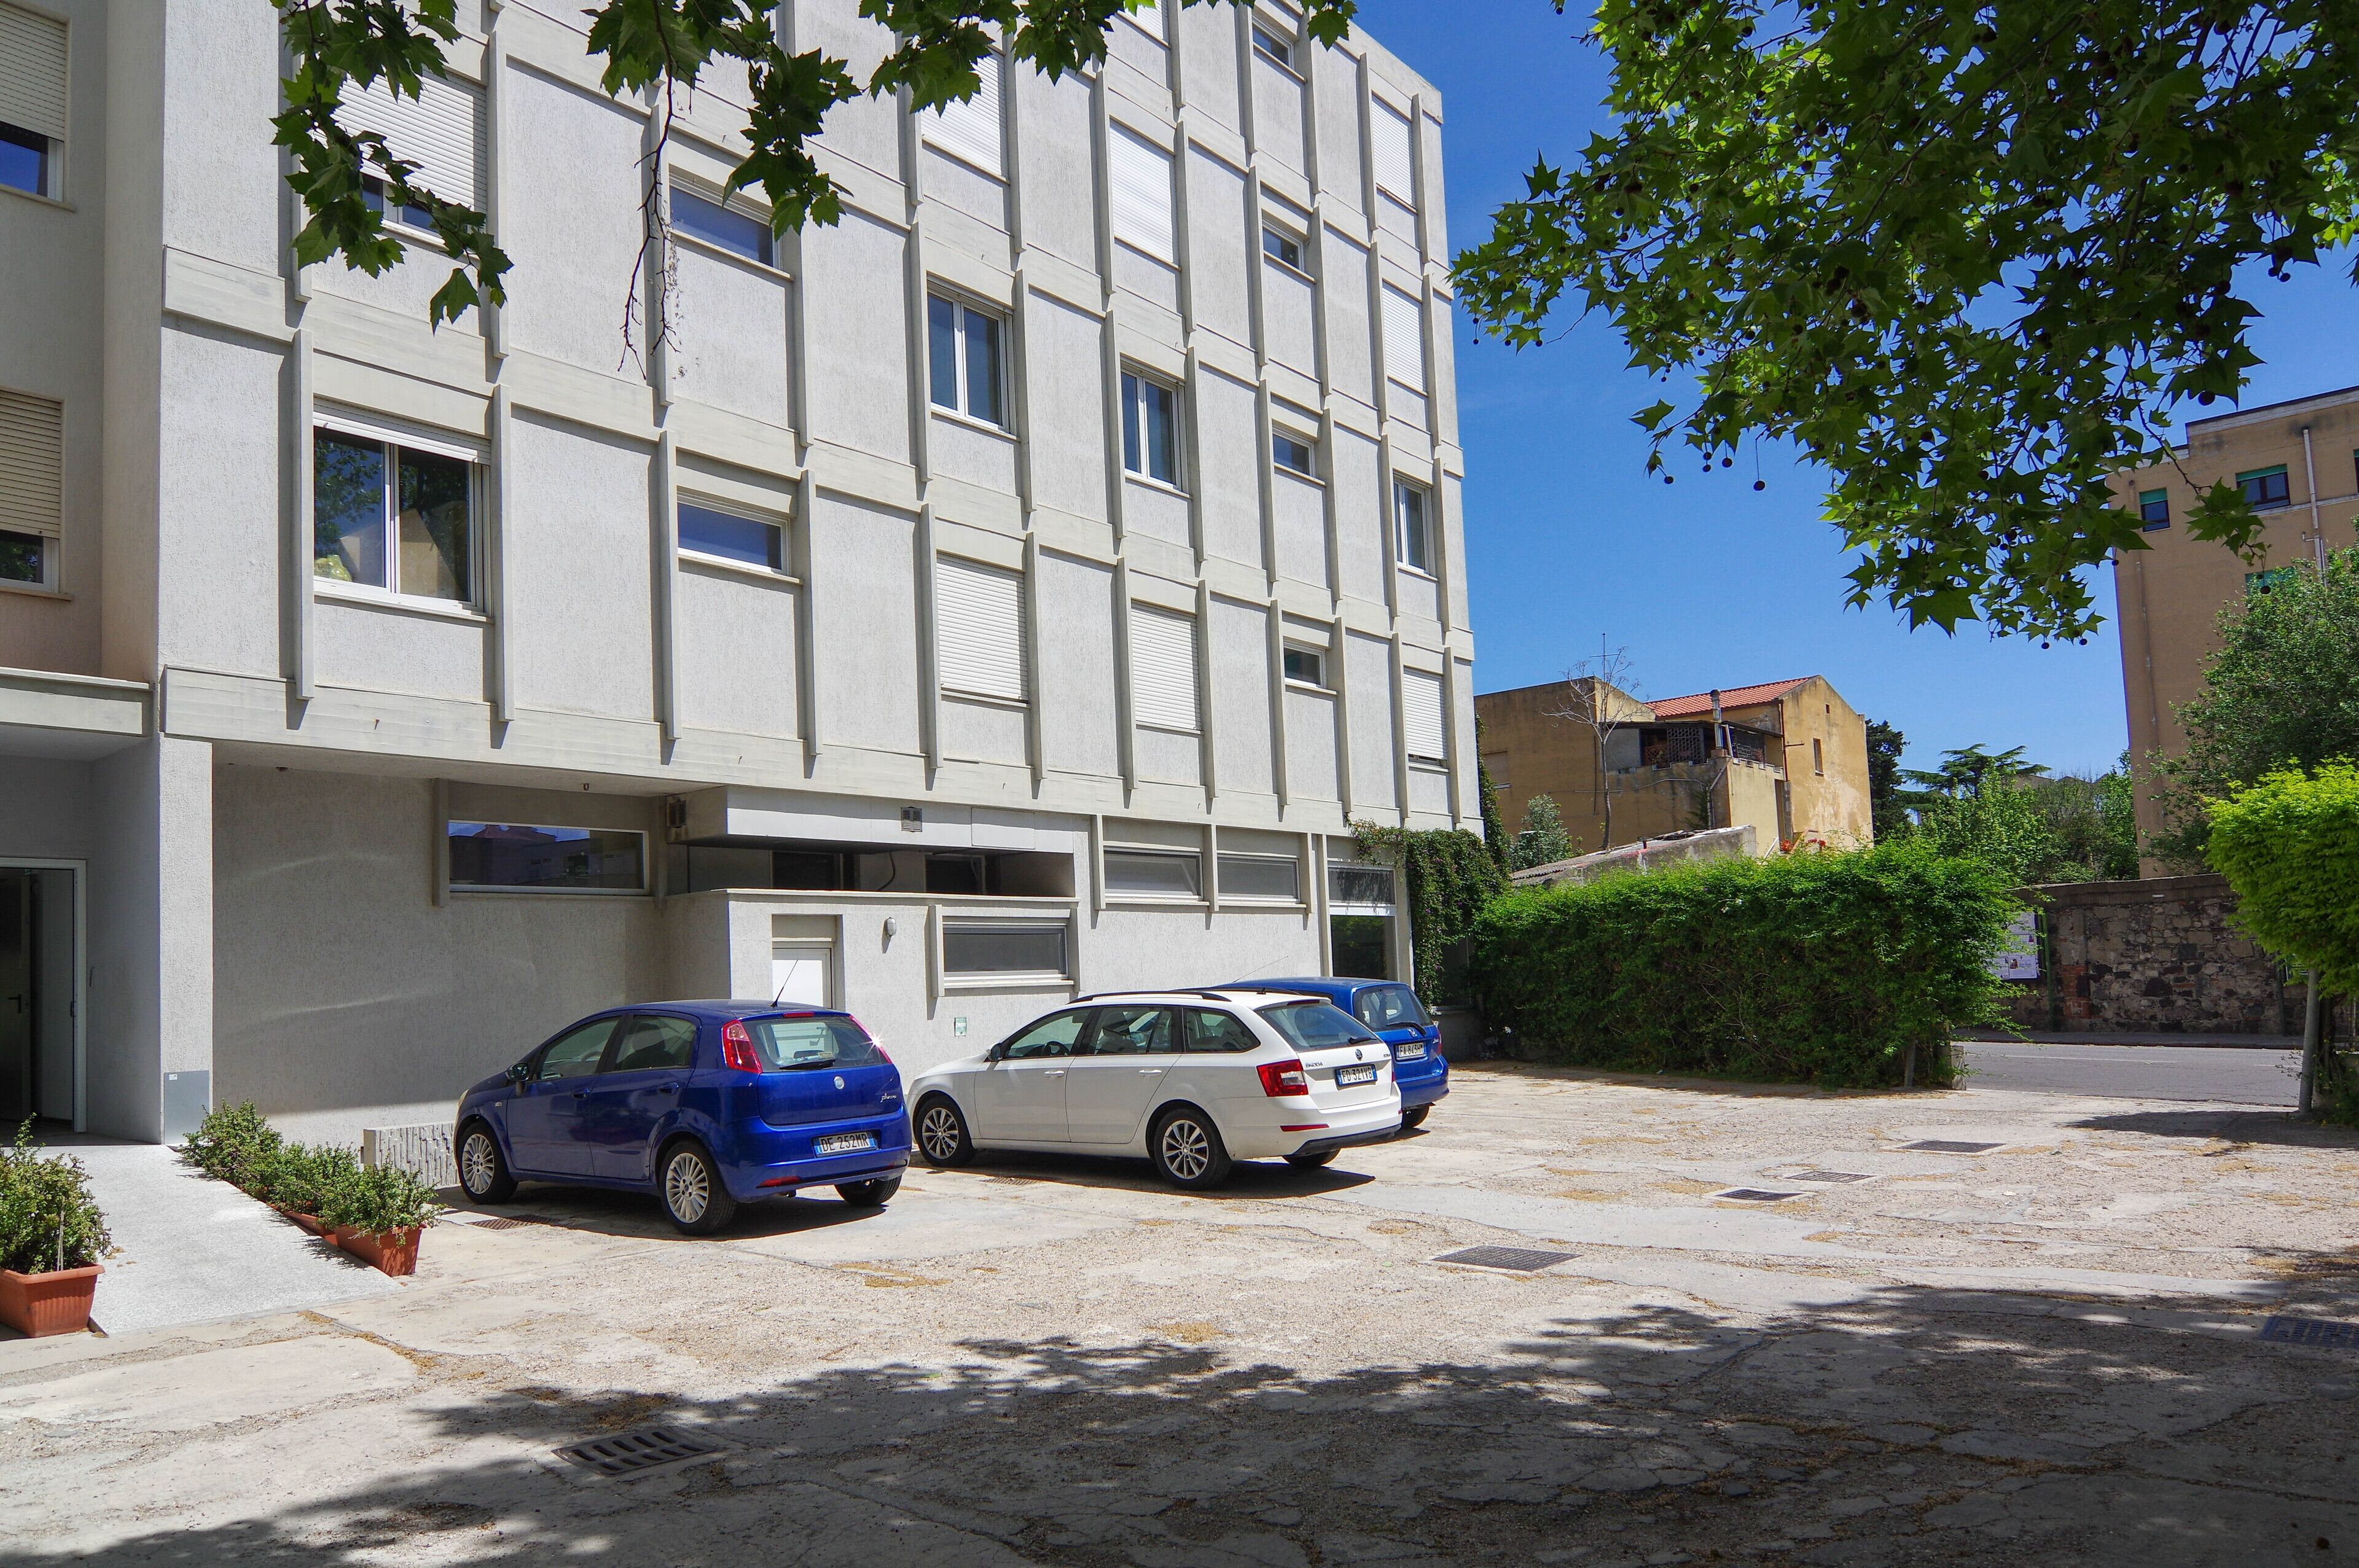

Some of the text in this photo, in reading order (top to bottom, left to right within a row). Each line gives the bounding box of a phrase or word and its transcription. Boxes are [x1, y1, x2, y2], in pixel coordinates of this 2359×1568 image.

[1400, 1046, 1406, 1056] FA
[1342, 1070, 1351, 1082] FD
[821, 1133, 869, 1152] DE 252MR
